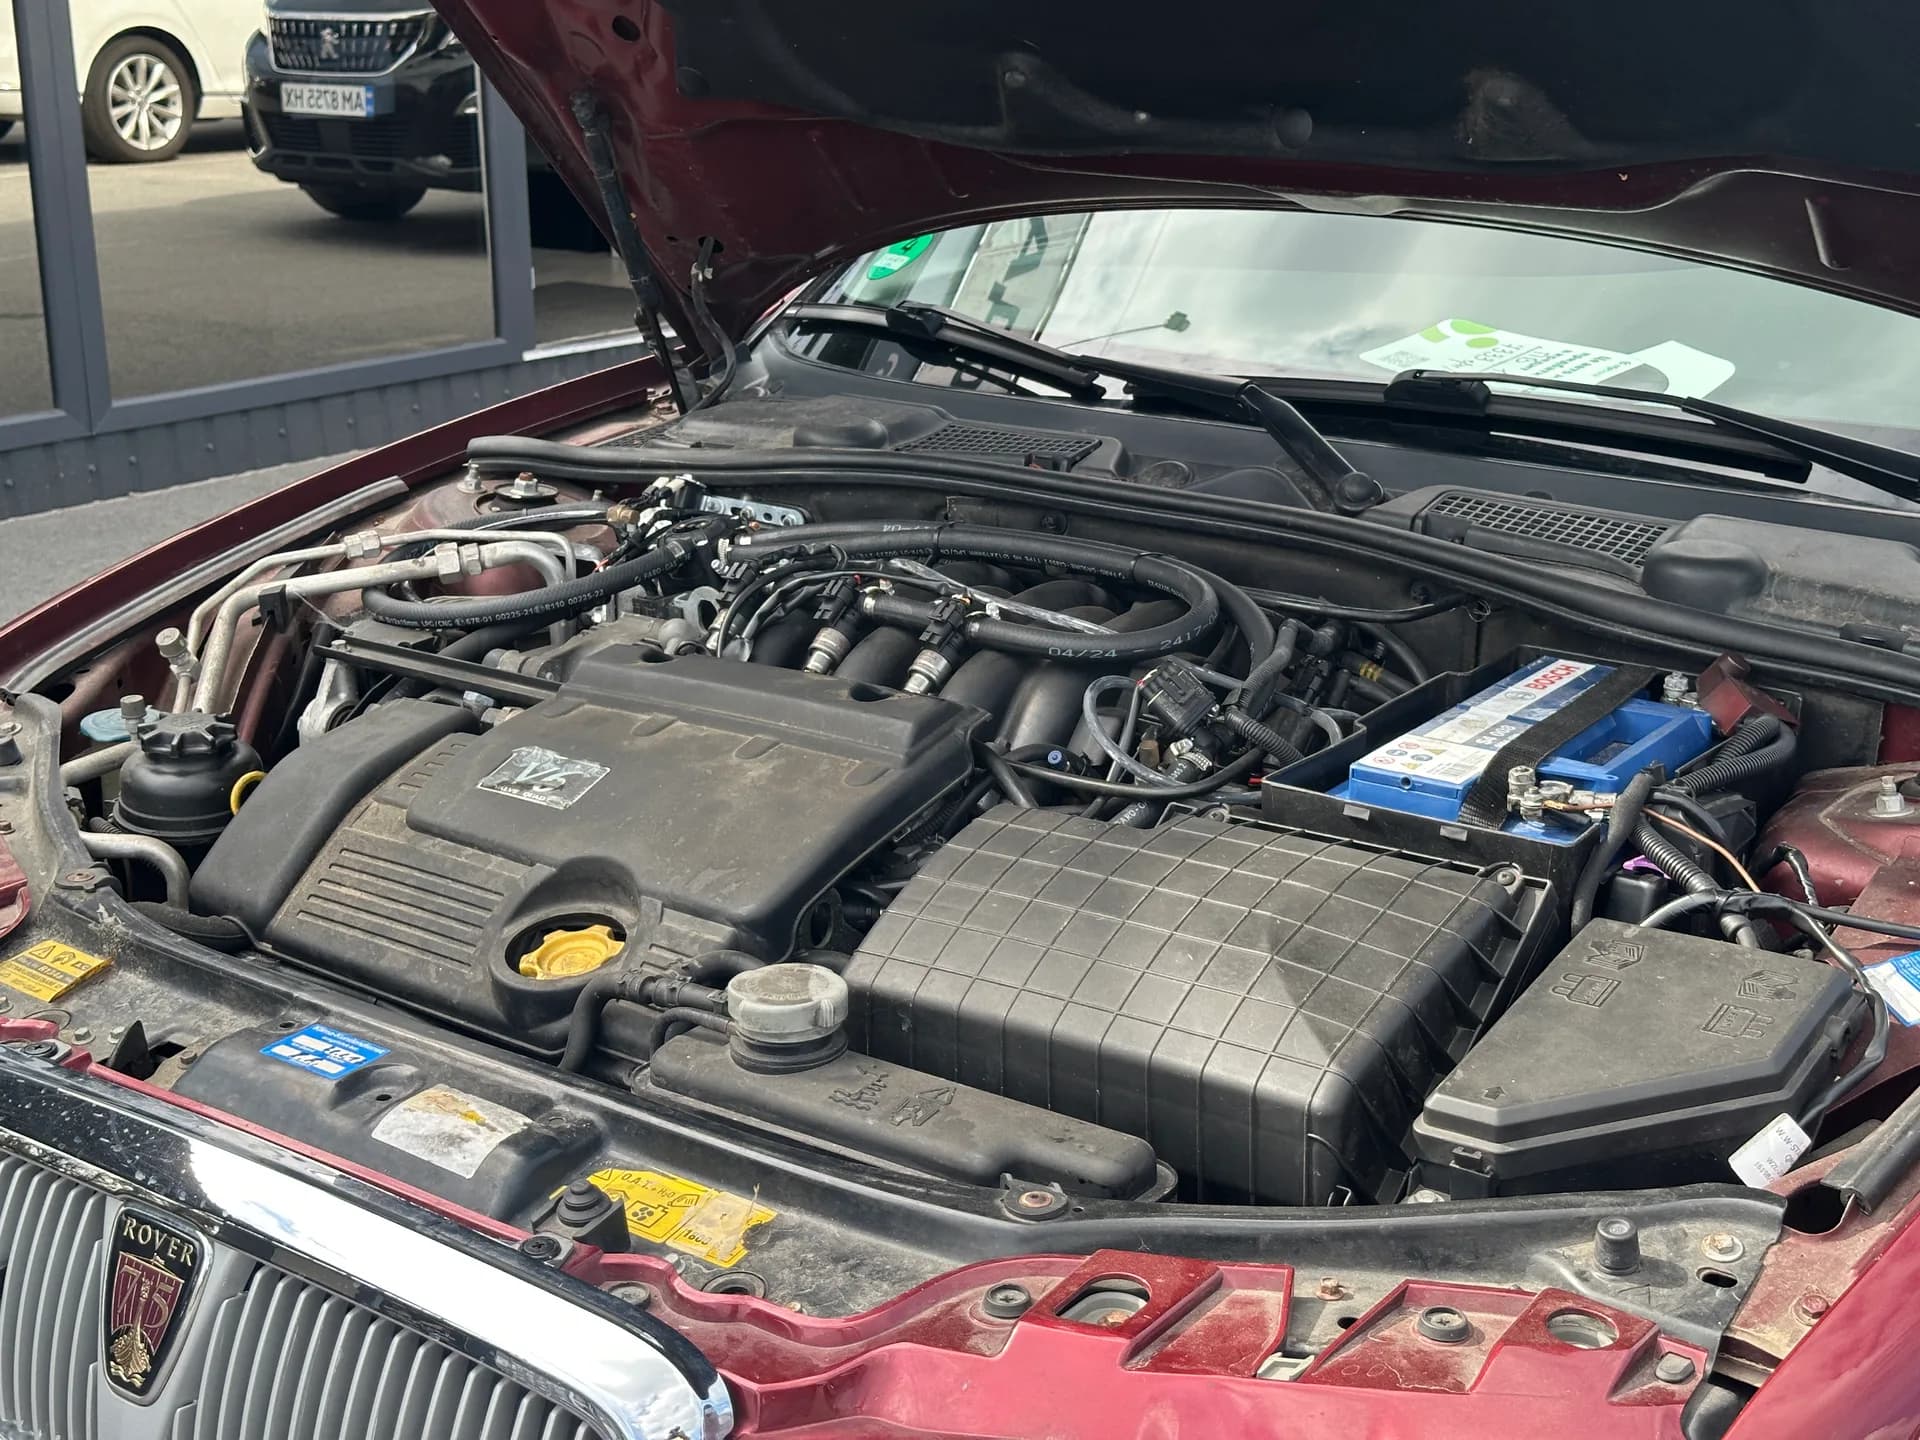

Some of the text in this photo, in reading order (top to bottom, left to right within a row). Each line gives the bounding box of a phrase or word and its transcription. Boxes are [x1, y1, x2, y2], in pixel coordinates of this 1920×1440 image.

[1048, 647, 1118, 659] 04/24
[1523, 664, 1581, 691] BOSCH
[122, 1215, 195, 1267] ROVER
[117, 1263, 175, 1329] 75
